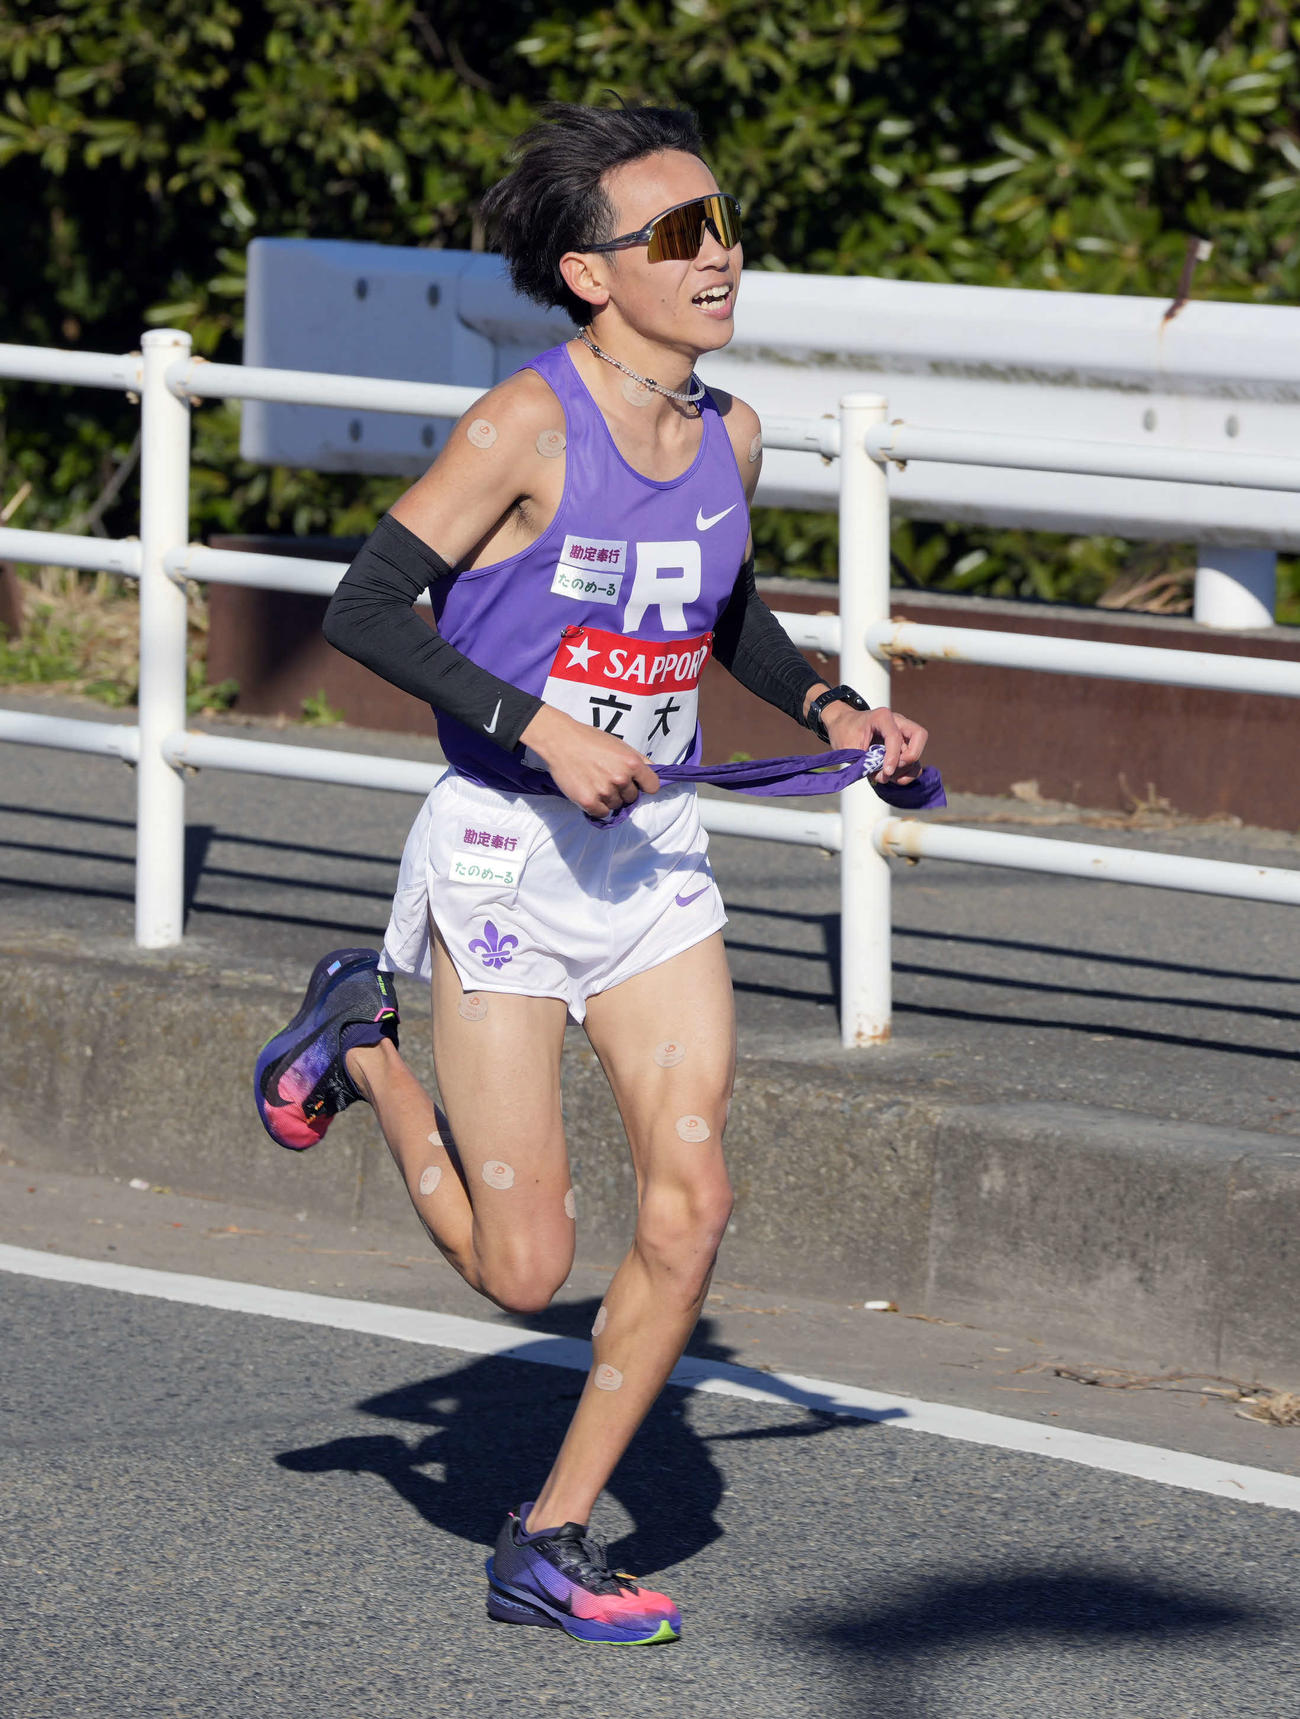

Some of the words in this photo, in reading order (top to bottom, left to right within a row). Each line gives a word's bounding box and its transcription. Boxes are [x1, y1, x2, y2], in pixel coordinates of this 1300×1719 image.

[568, 543, 621, 565] 勘定奉行
[557, 573, 617, 597] たのめーる
[622, 540, 702, 633] R
[463, 828, 519, 852] 勘定奉行
[455, 861, 515, 884] たのめーる
